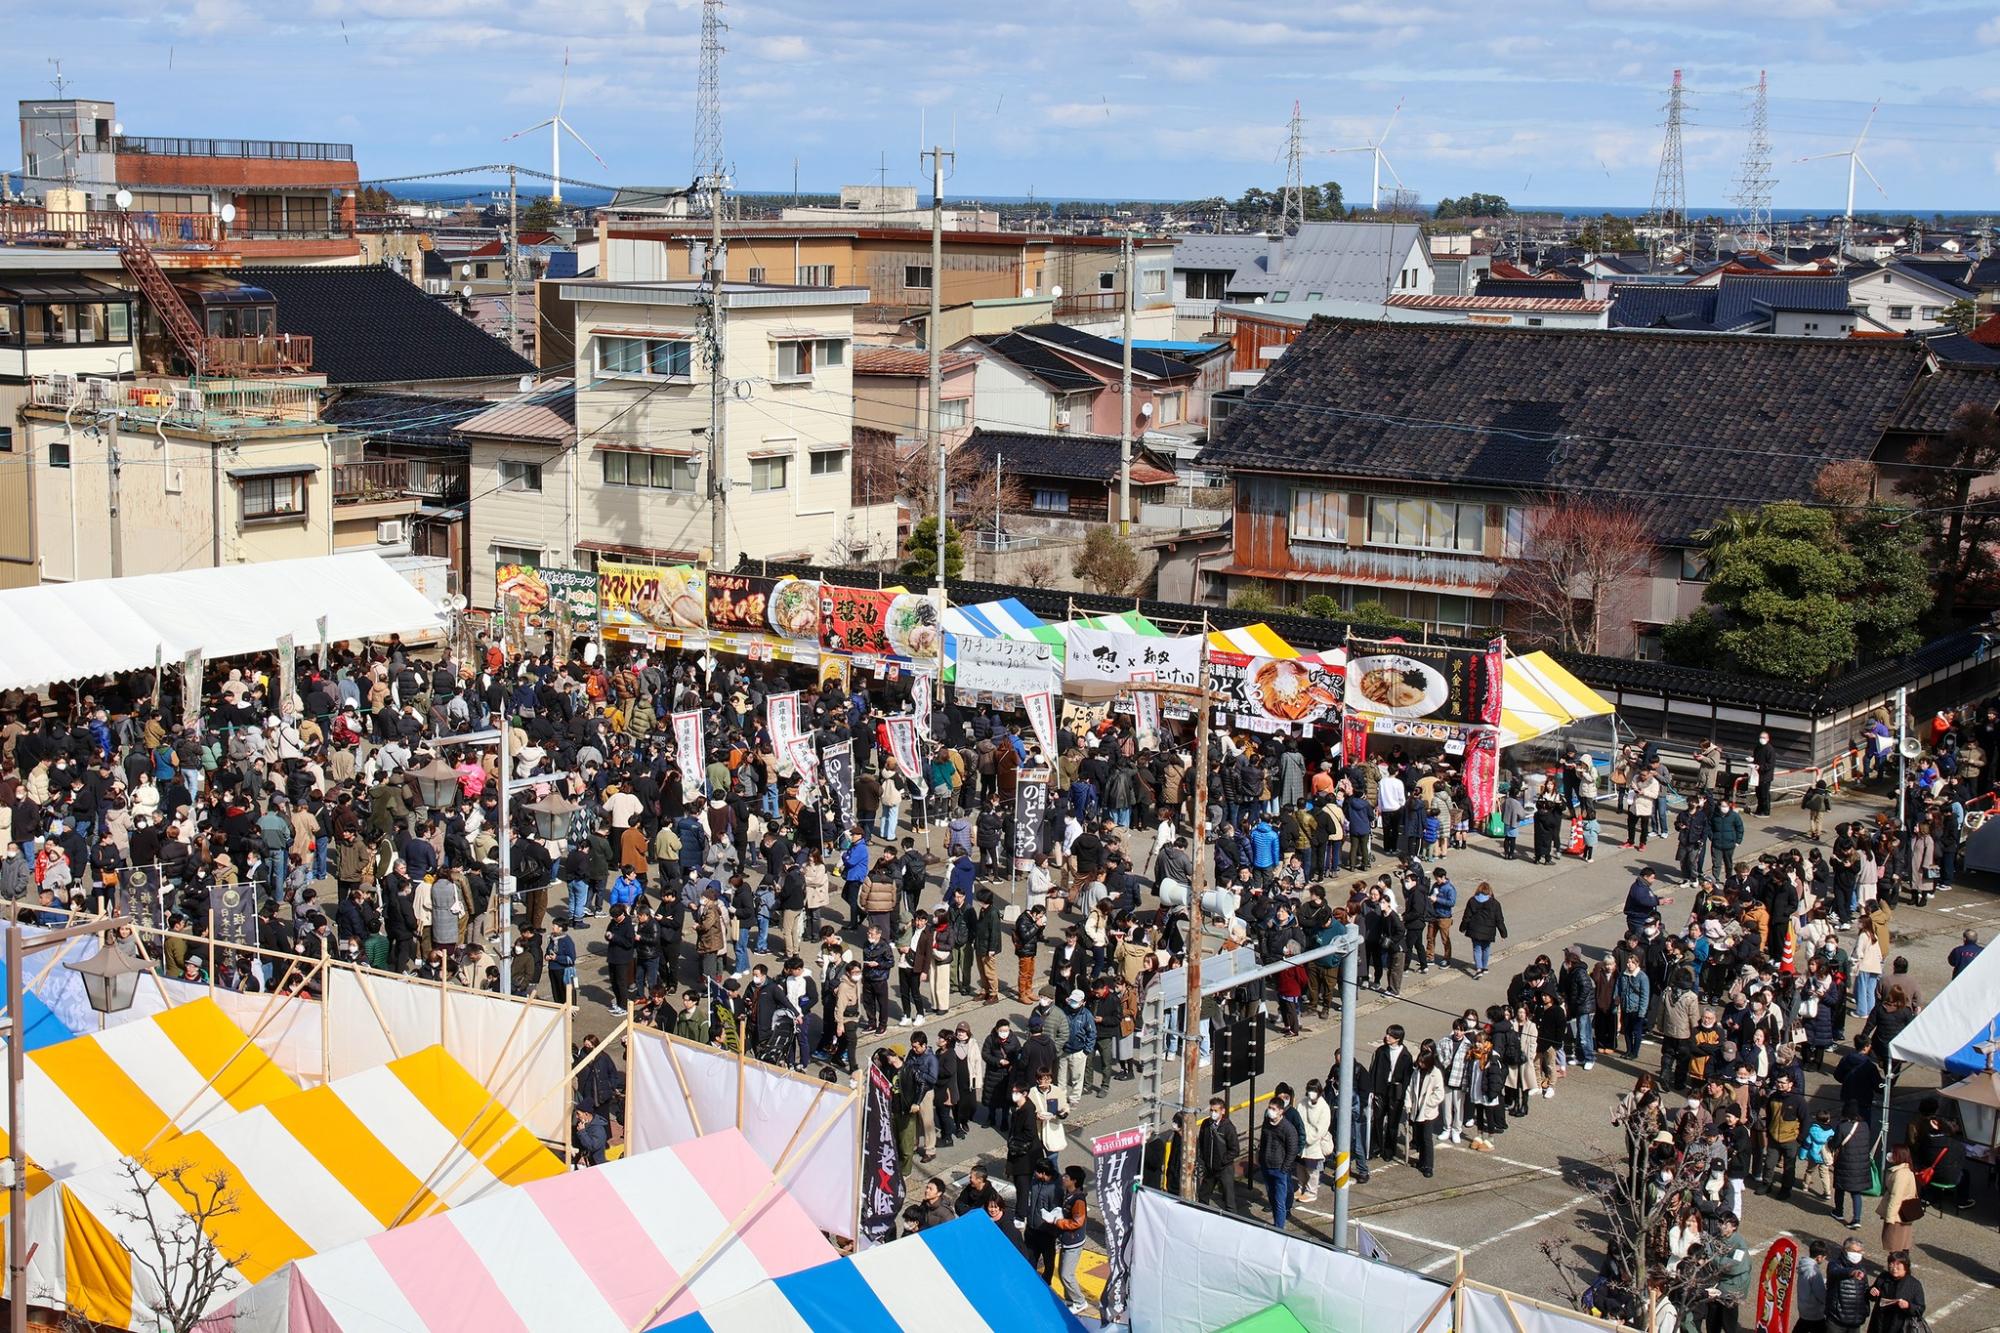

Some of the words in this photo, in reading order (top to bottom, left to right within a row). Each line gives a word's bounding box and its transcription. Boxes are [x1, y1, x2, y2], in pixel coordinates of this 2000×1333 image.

[835, 600, 878, 625] 醤油
[846, 627, 889, 650] 豚骨
[1093, 645, 1121, 674] 想
[1450, 658, 1463, 716] 黄金淡麗
[1023, 784, 1038, 852] のどぐろ
